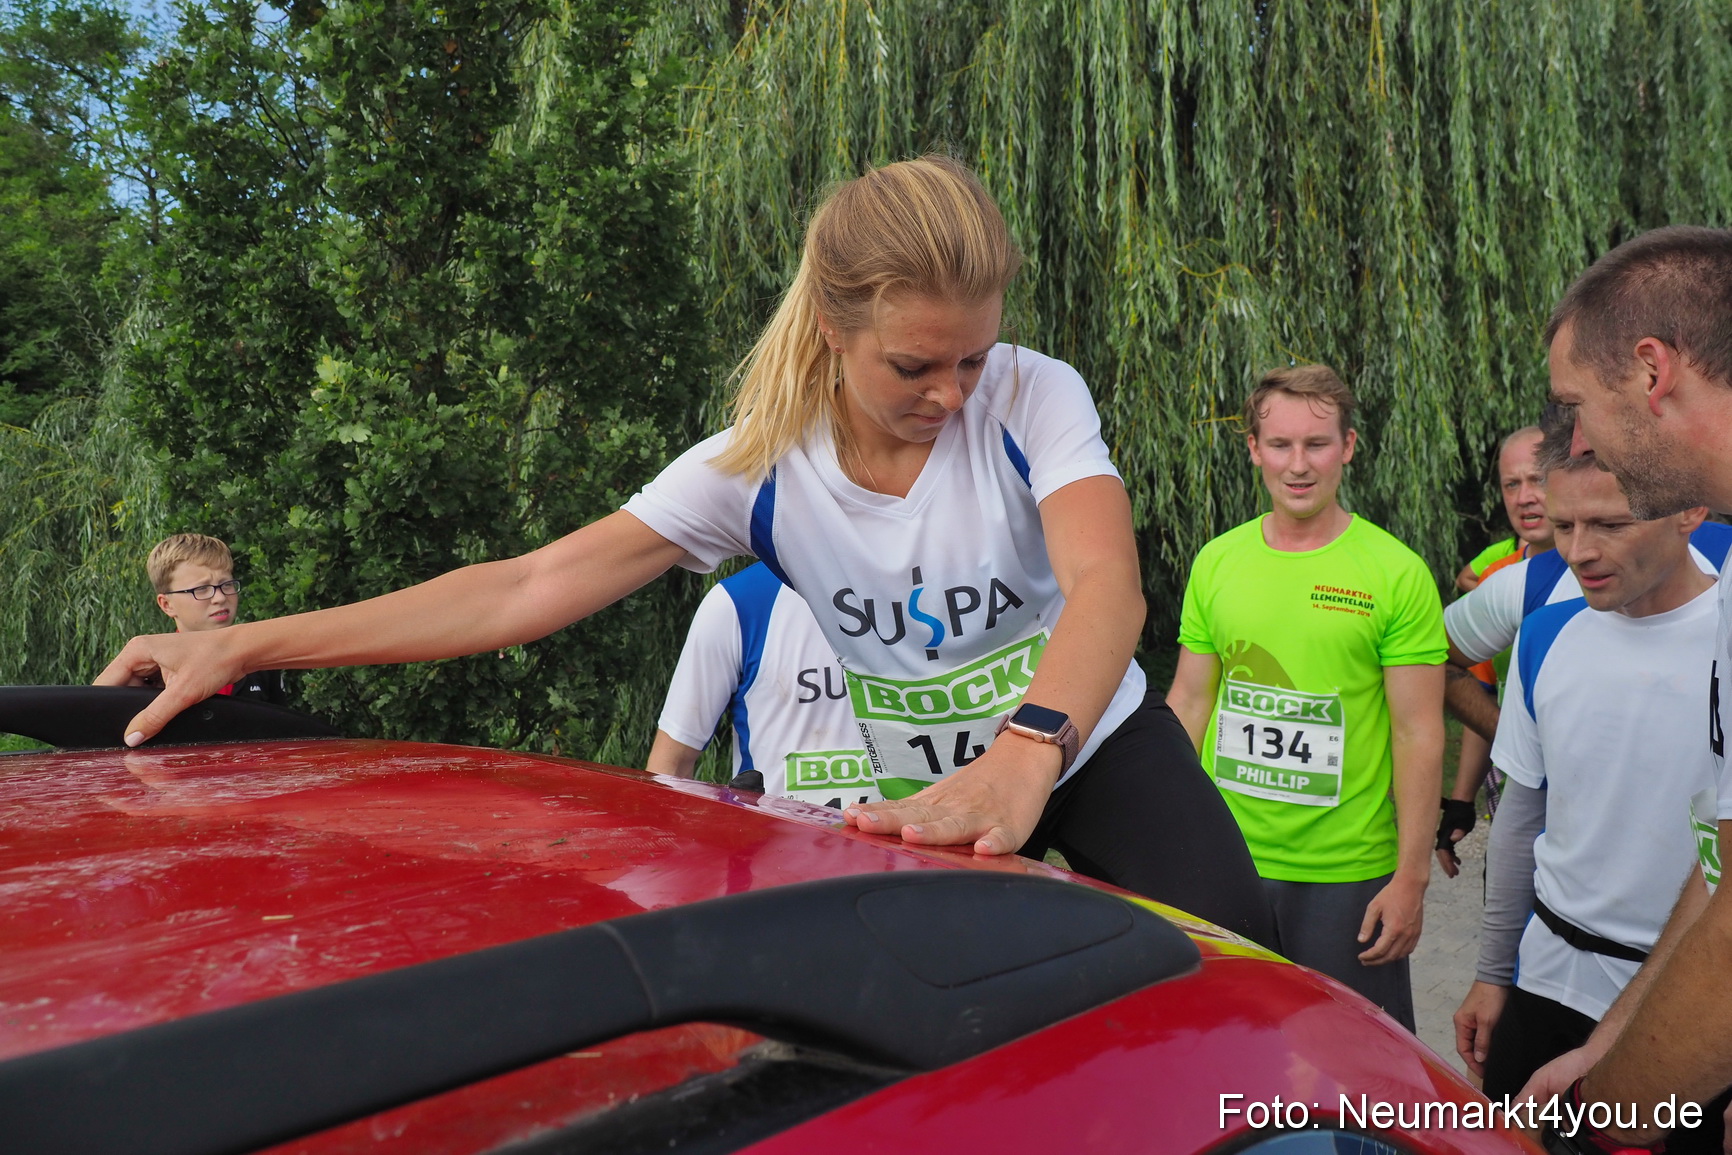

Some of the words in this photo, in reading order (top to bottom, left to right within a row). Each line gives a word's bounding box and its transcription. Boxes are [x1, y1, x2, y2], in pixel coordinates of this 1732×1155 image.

[1310, 593, 1375, 611] ELEMENTELAUF
[1314, 585, 1373, 600] NEUMARKTER
[1322, 604, 1355, 614] September
[832, 565, 1024, 661] SUSPA
[797, 667, 848, 704] SU
[866, 648, 1034, 718] BOCK
[1229, 687, 1333, 721] BOCK
[1242, 723, 1312, 764] 134
[1236, 765, 1310, 790] PHILLIP
